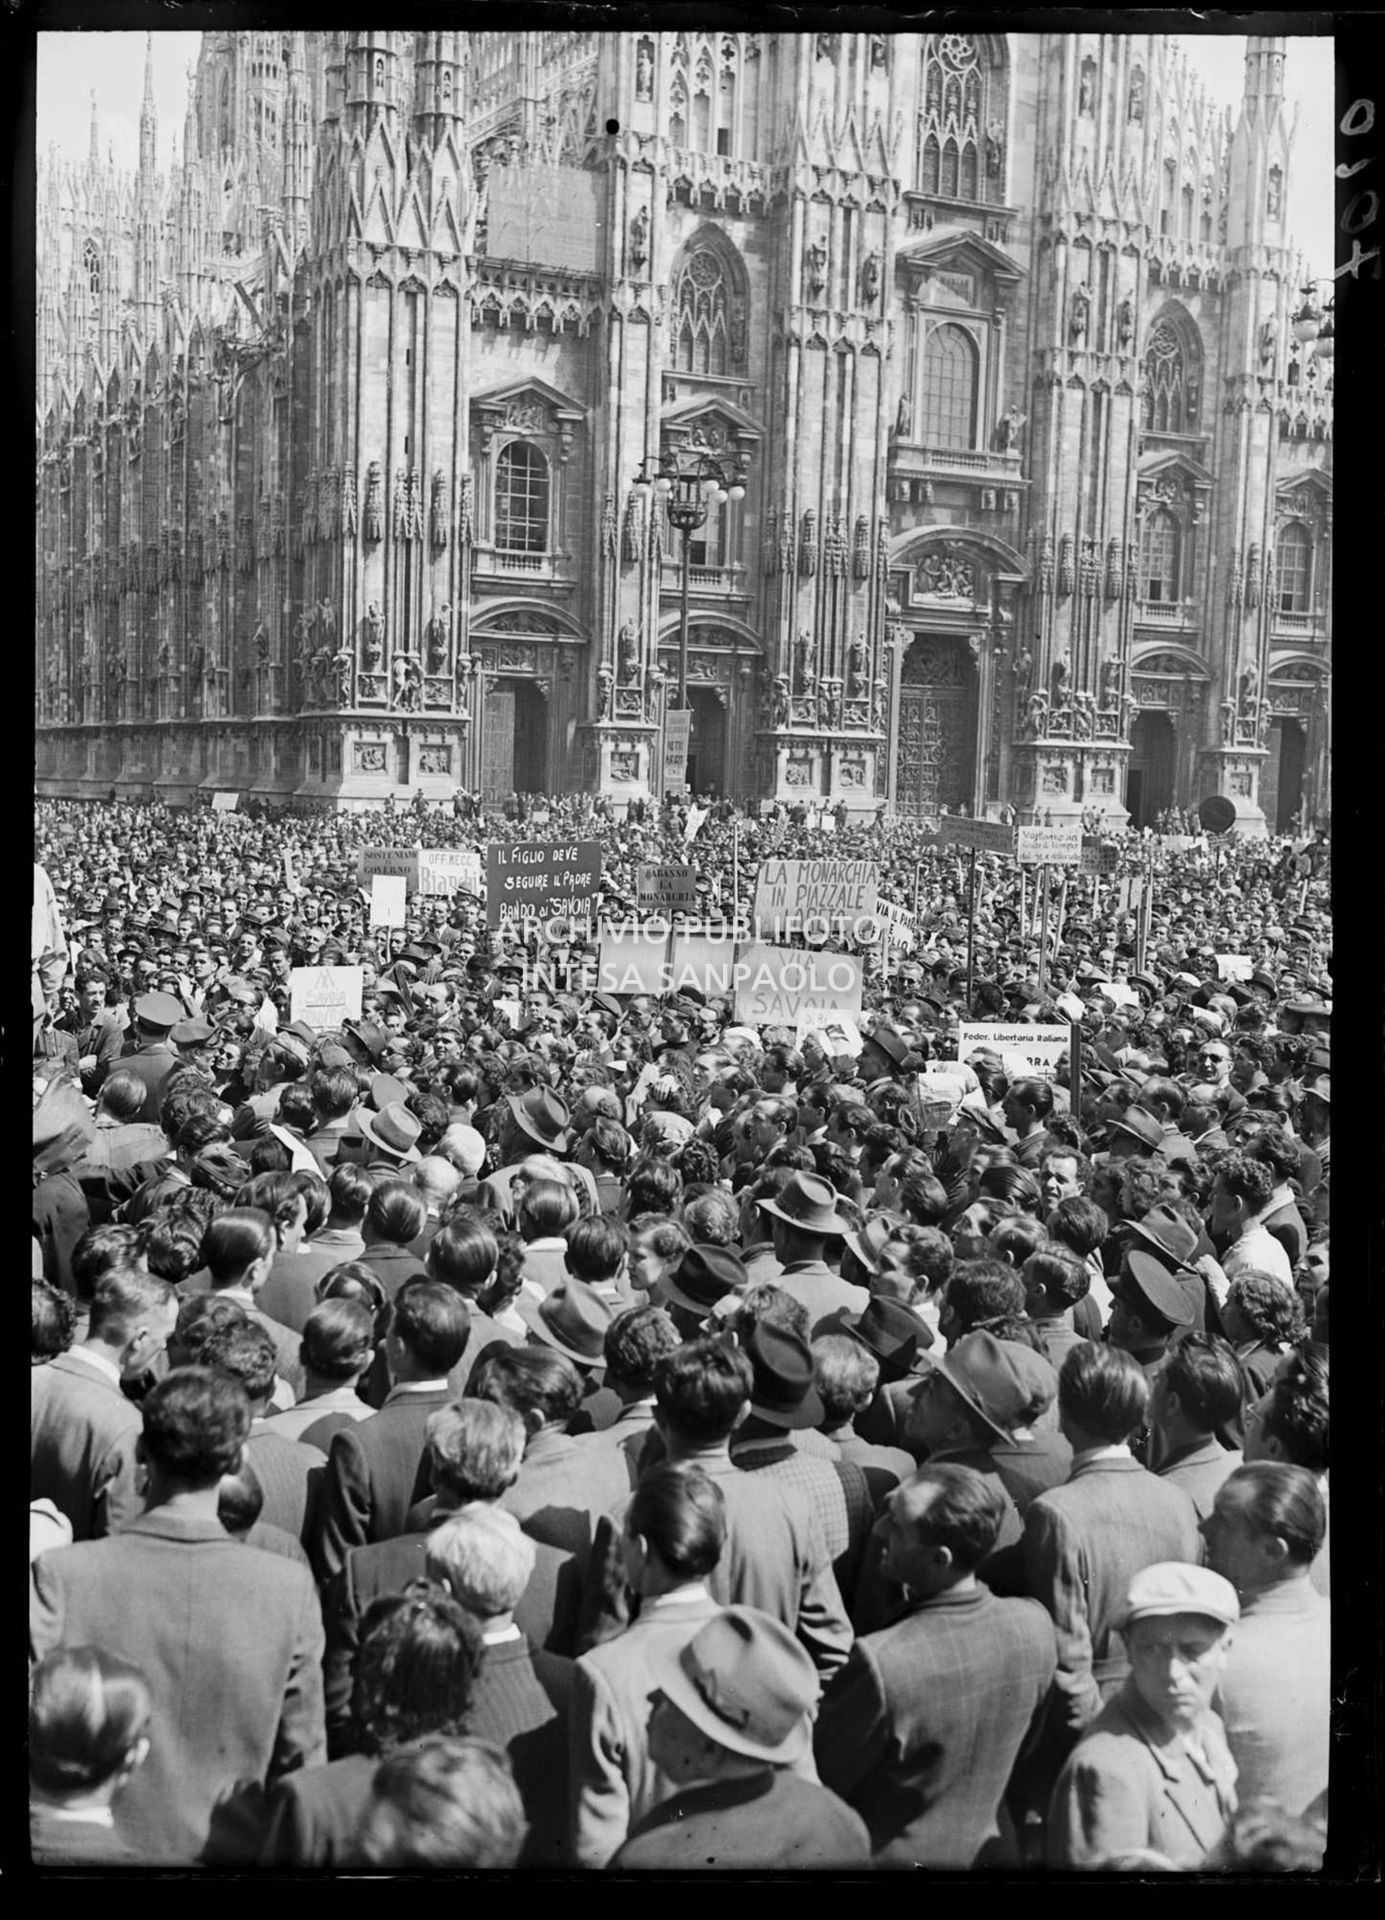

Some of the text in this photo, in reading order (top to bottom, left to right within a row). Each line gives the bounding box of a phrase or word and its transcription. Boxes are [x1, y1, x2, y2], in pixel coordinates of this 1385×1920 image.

[498, 845, 578, 865] IL FIGLIO DEVE
[363, 865, 411, 874] GOVERNO
[764, 862, 877, 885] LA MONARCHIA
[504, 870, 592, 892] SEGUIRE IL PADRE
[771, 884, 866, 909] IN PIAZZALE
[500, 900, 536, 922] BANDO
[876, 900, 889, 917] VIA
[963, 1032, 1068, 1043] Feder. Libertaria Italiana
